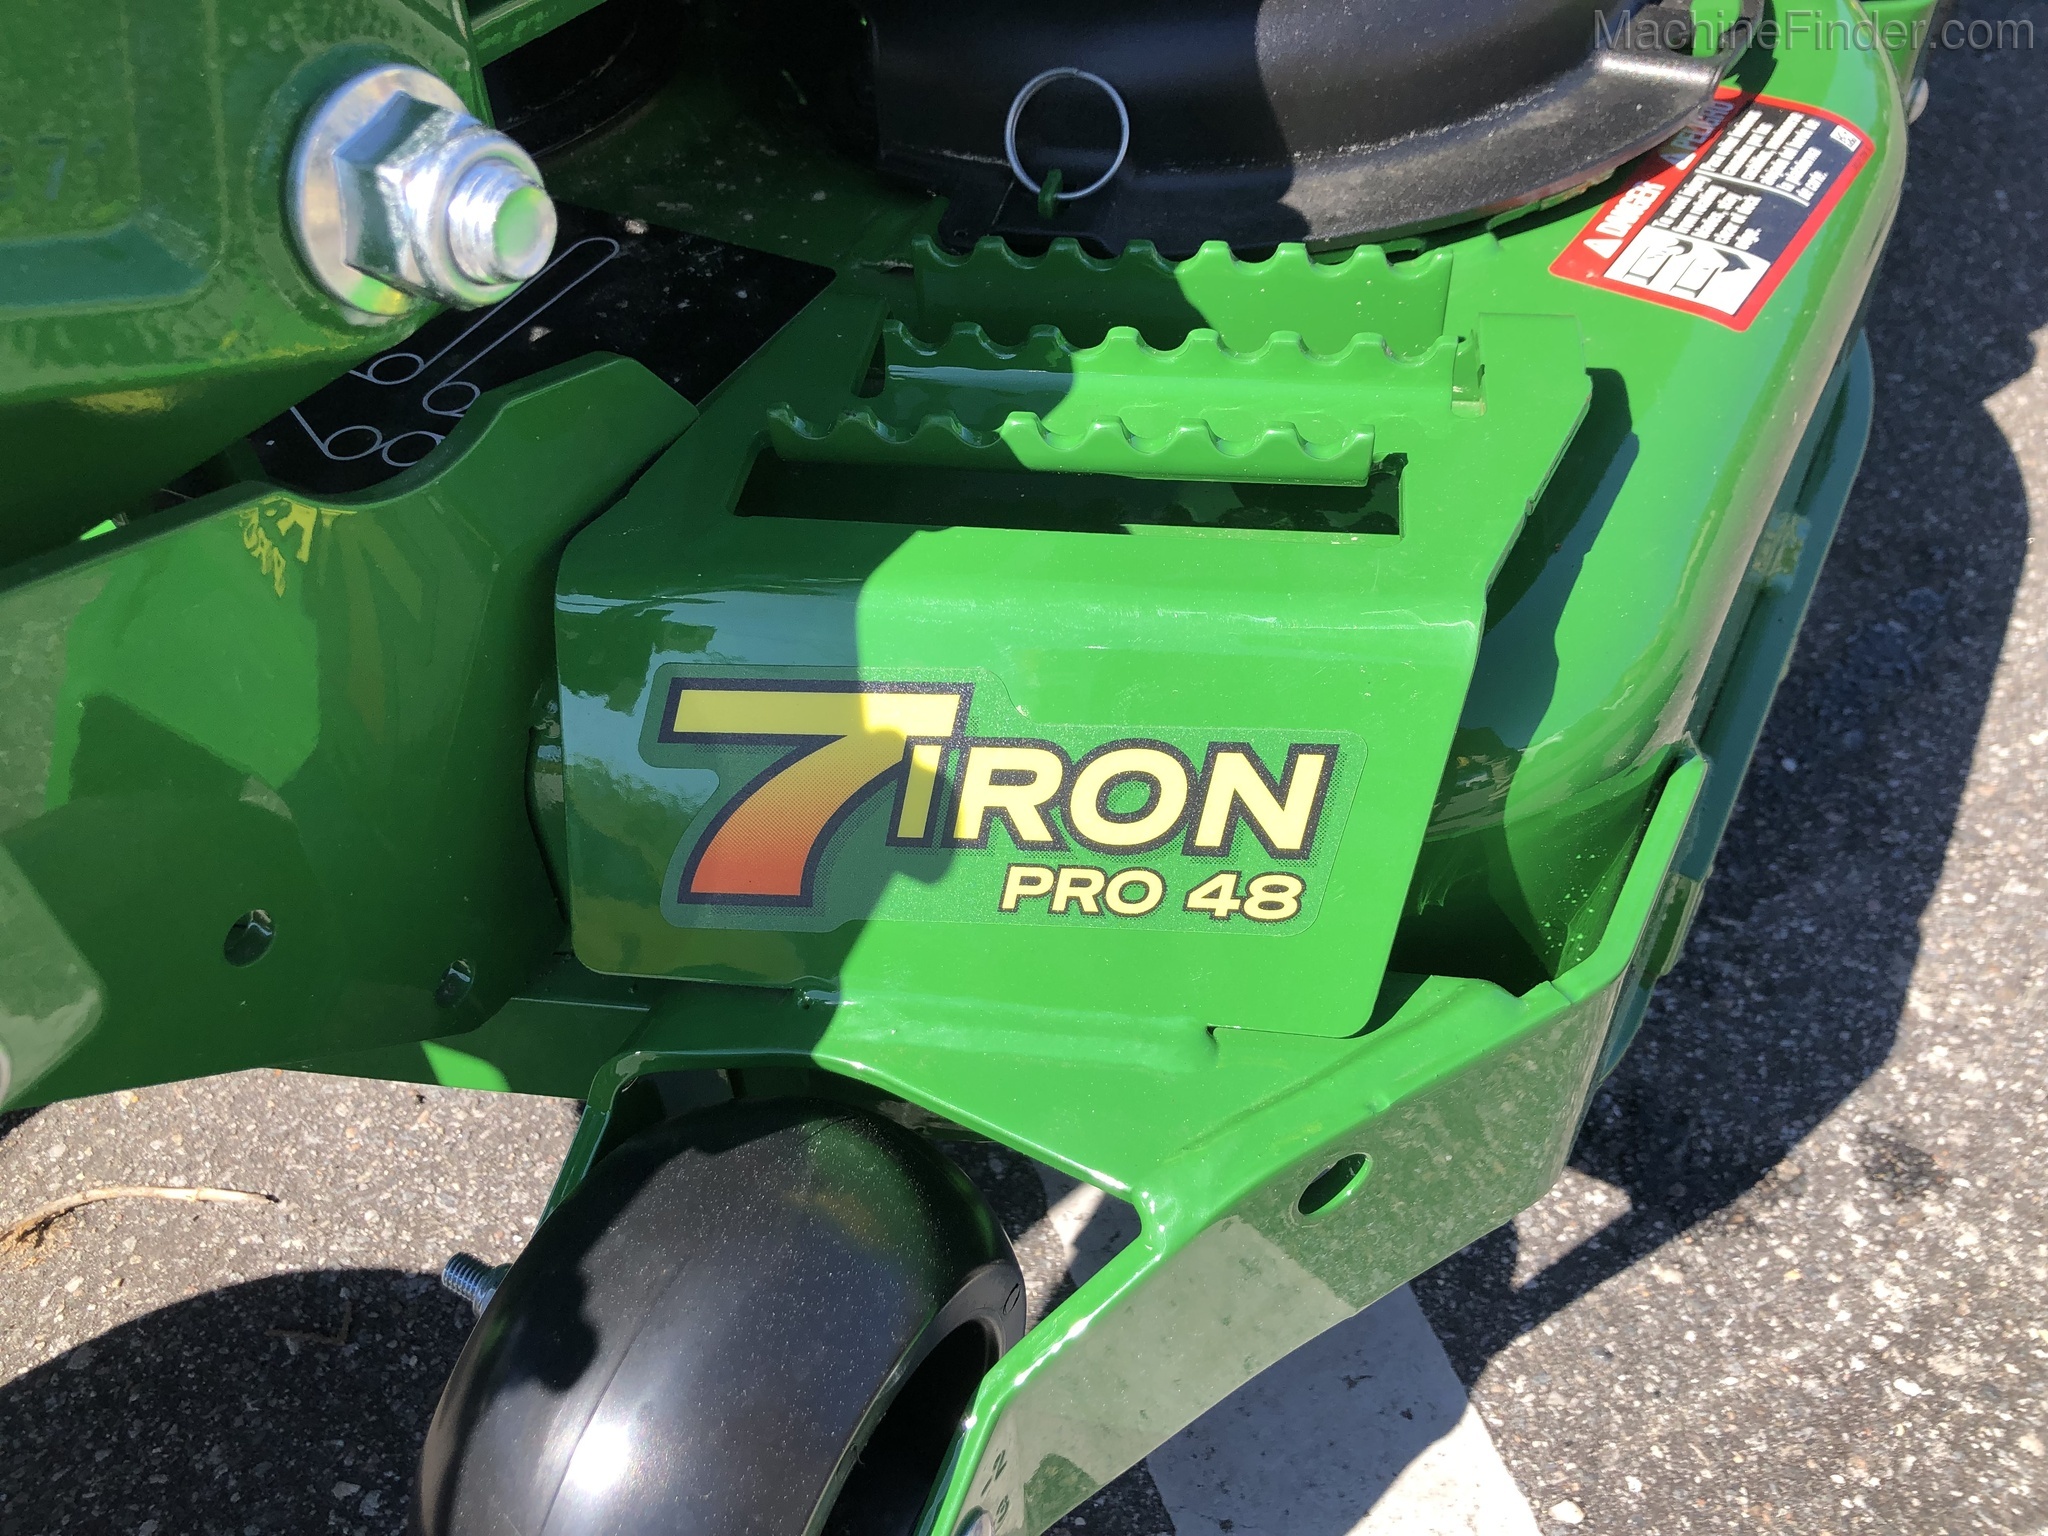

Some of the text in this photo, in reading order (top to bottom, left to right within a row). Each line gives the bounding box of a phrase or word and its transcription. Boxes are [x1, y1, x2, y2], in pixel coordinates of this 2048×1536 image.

[1595, 180, 1666, 238] DANGER
[1651, 215, 1674, 231] To
[997, 863, 1307, 923] PRO 48
